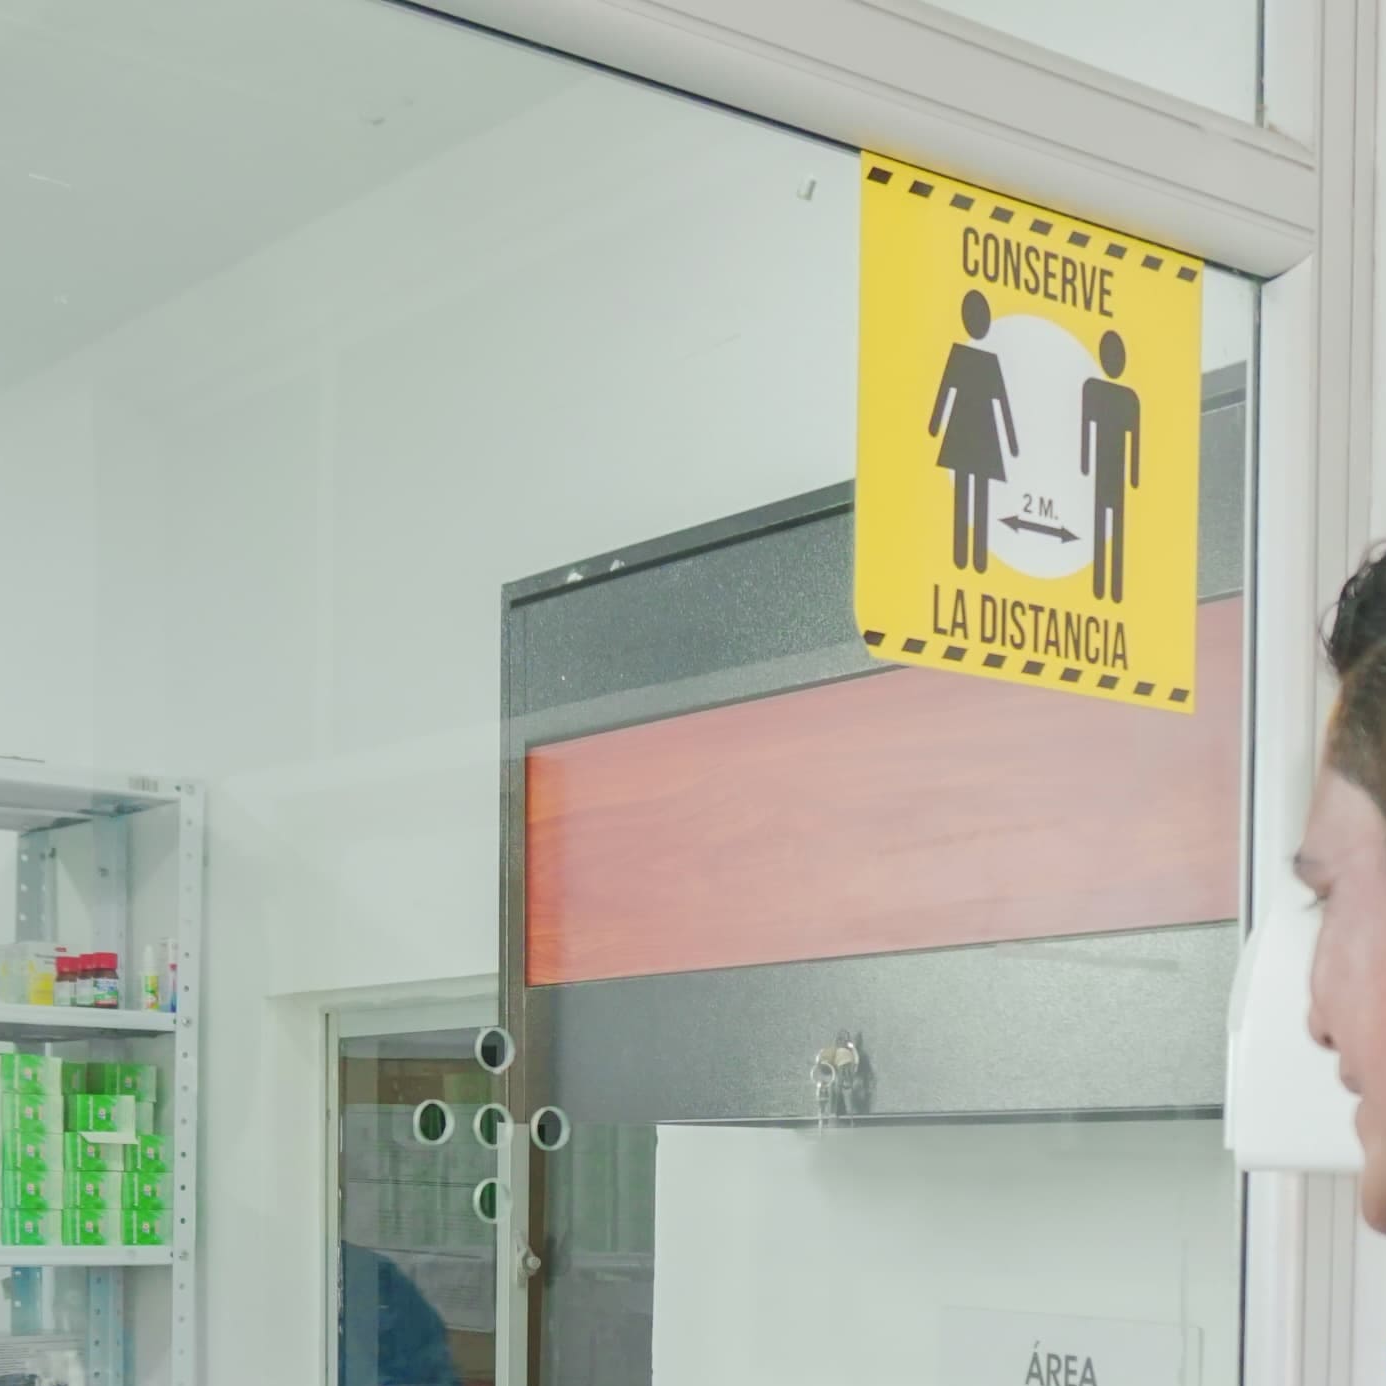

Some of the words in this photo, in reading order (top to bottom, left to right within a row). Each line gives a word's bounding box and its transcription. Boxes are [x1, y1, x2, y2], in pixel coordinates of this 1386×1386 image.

[963, 226, 1114, 318] CONSERVE
[1022, 493, 1033, 514] 2
[1038, 496, 1060, 520] M.
[932, 583, 969, 640] LA
[980, 593, 1128, 671] DISTANCIA
